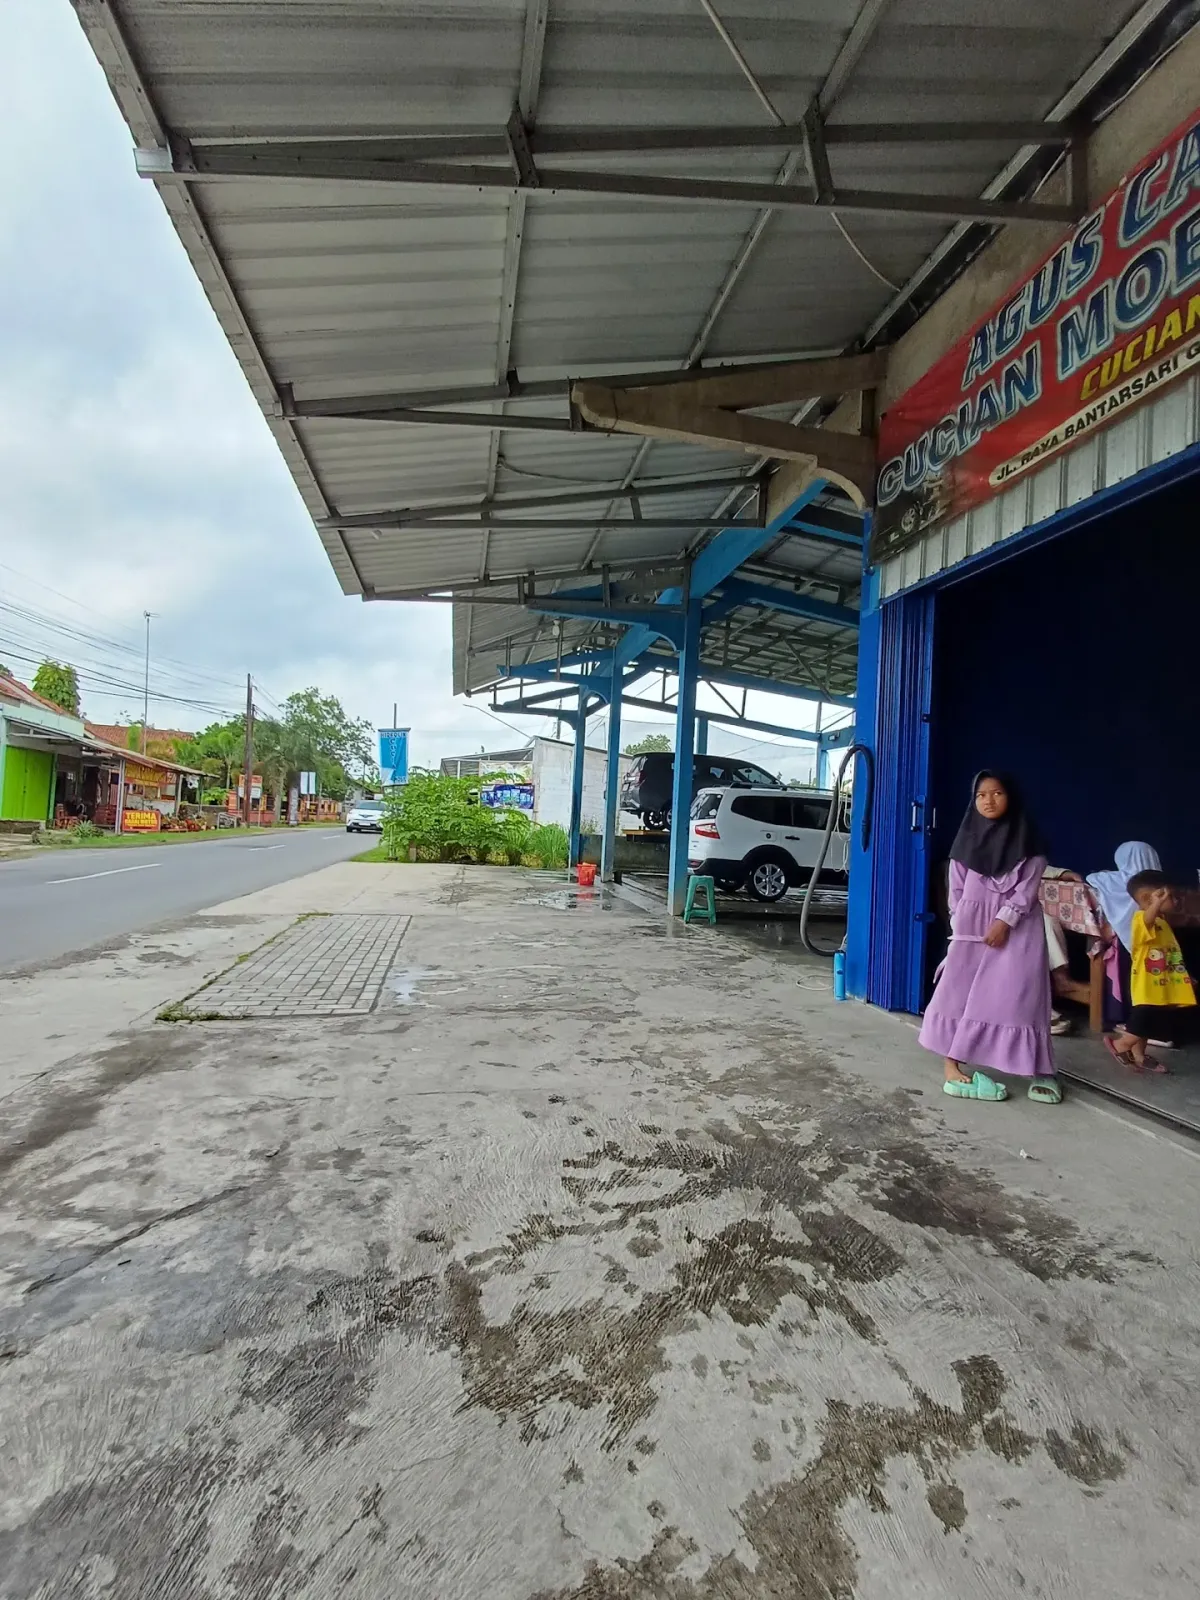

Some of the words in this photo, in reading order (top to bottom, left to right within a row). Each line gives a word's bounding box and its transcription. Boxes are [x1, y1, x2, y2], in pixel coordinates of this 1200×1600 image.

[962, 207, 1103, 390] AGUS
[877, 341, 1042, 507] CUCIAN
[996, 464, 1018, 482] JL.
[1020, 434, 1060, 467] RAYA
[1063, 355, 1179, 440] BANTARSARI
[125, 812, 157, 820] TERIMA
